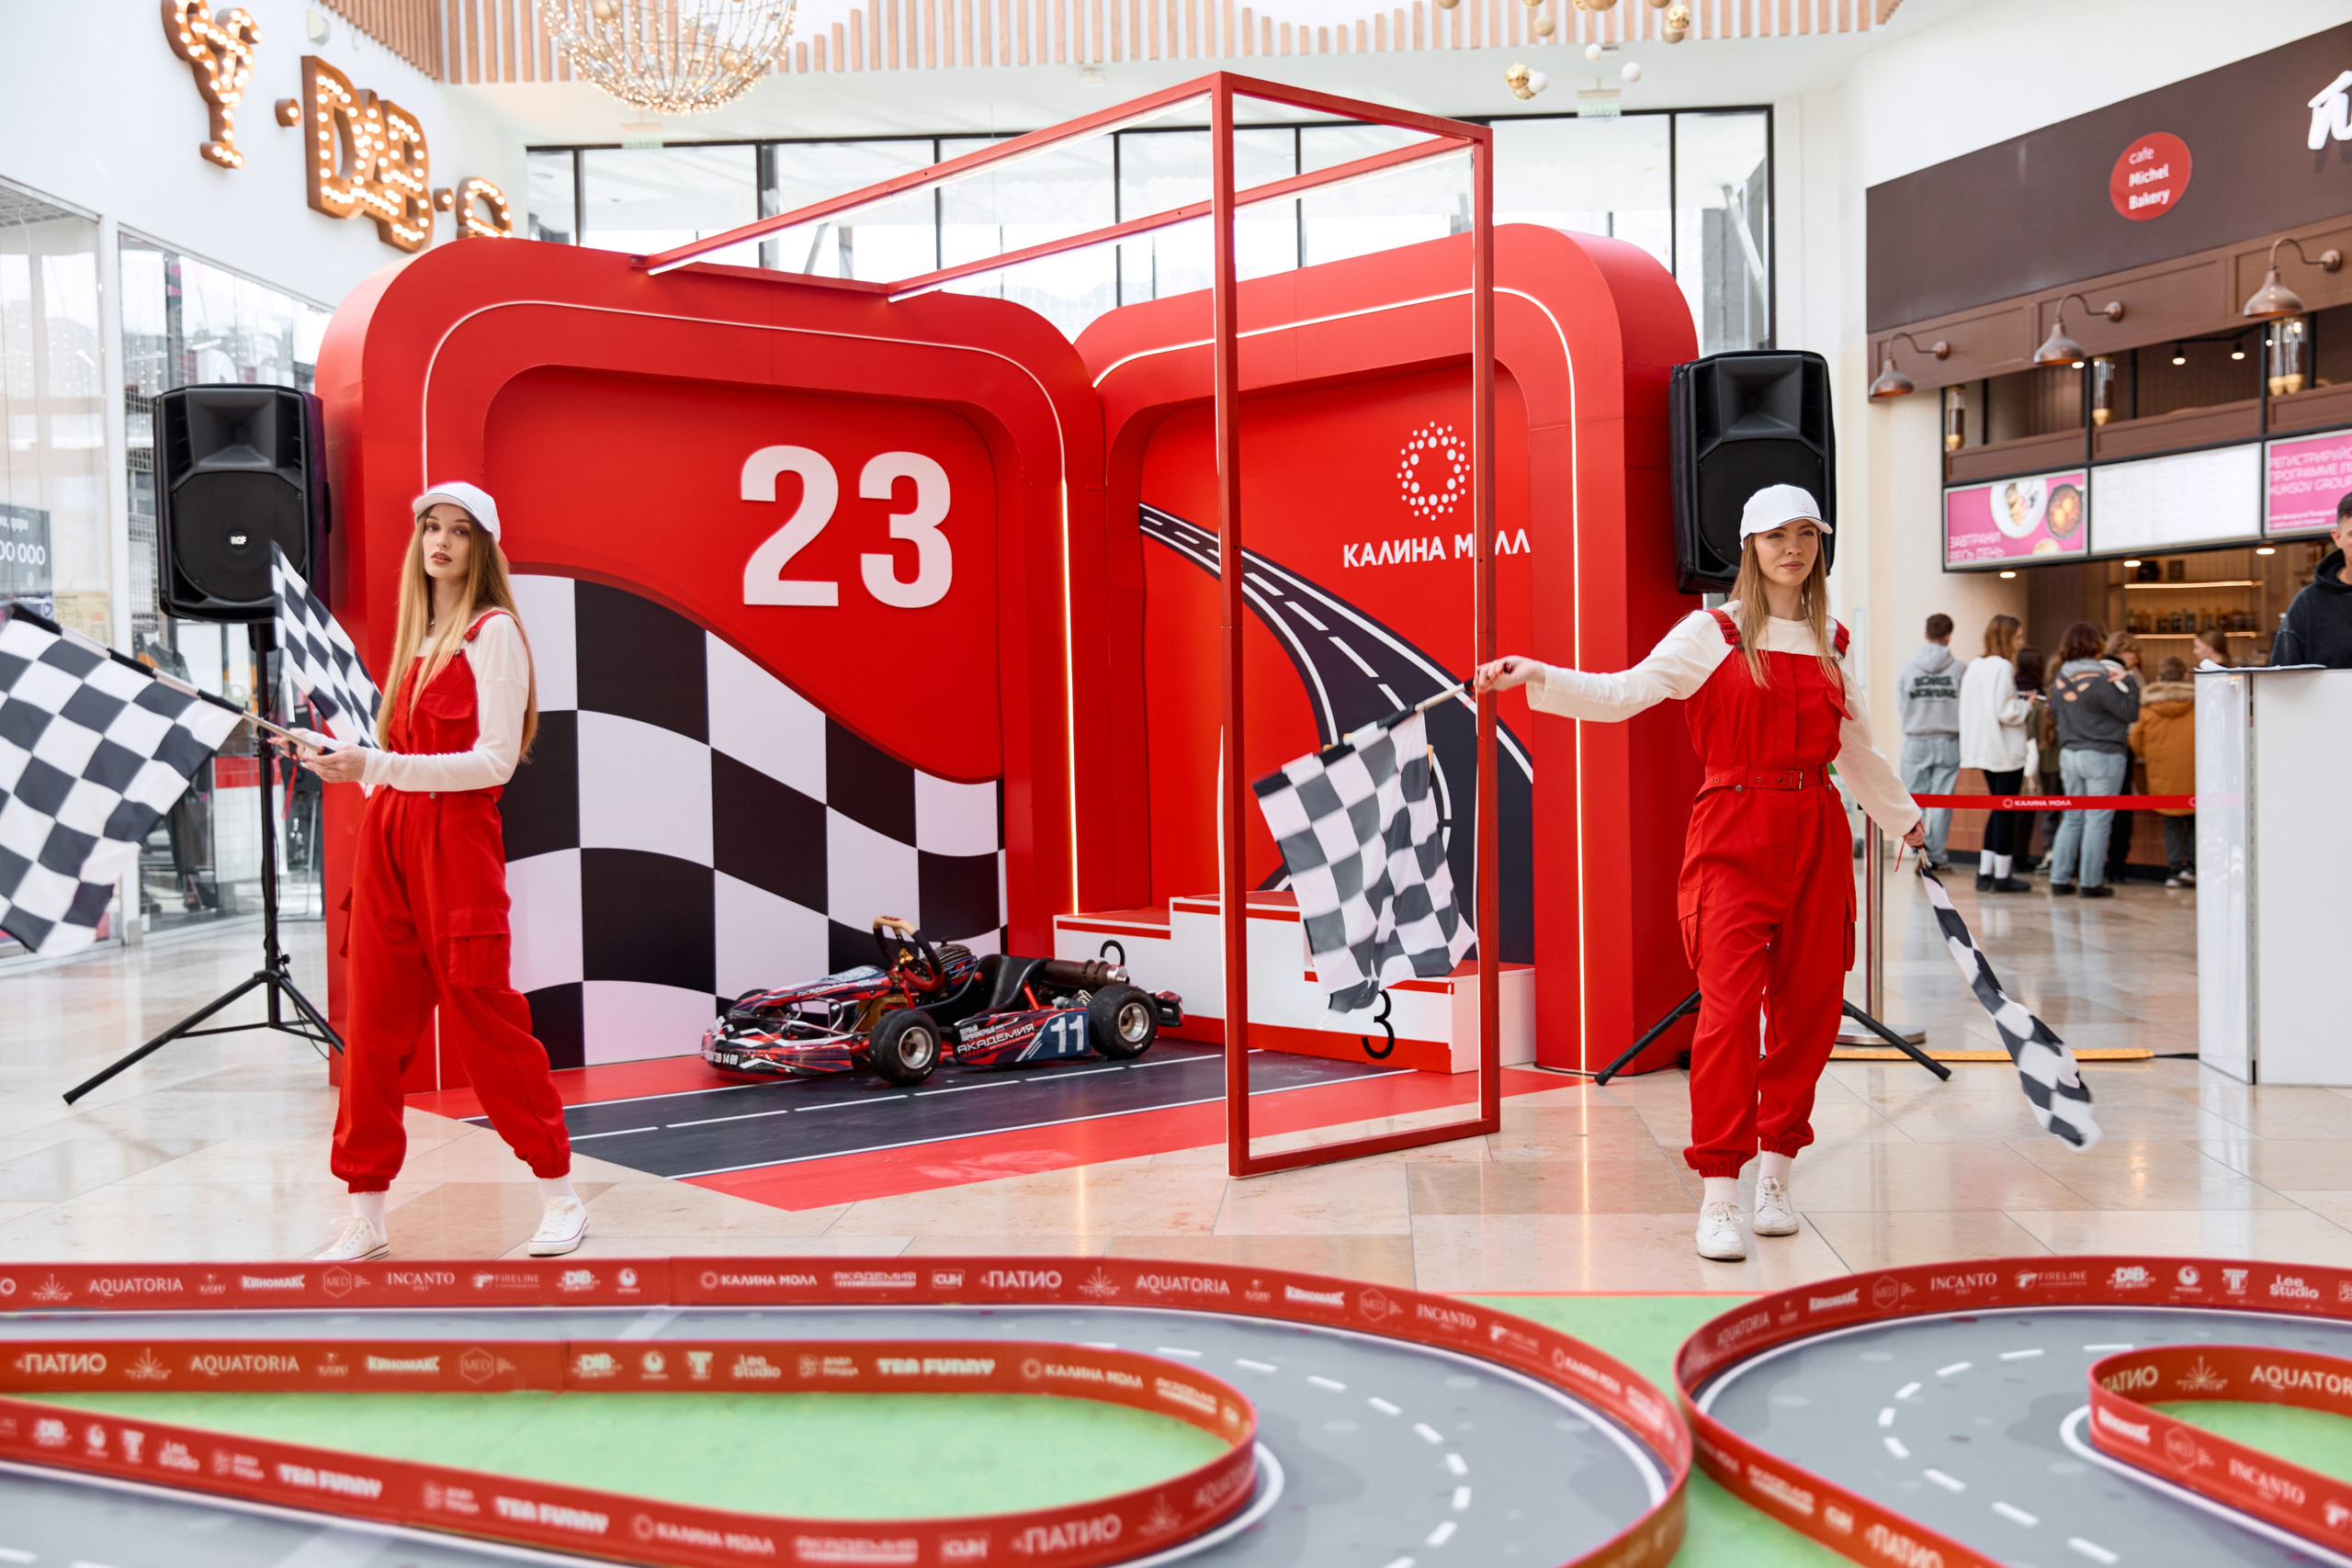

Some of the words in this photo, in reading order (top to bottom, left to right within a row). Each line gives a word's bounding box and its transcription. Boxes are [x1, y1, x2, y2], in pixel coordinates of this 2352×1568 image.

[2129, 146, 2154, 164] cafe
[2129, 163, 2169, 187] Michel
[2129, 189, 2170, 210] Bakery
[741, 445, 953, 608] 23
[1343, 536, 1446, 568] КАЛИНА
[1454, 528, 1532, 559] МЛЛ
[1362, 988, 1395, 1059] 3
[956, 1023, 1035, 1054] АКАДЕМИЯ
[1050, 1015, 1085, 1054] 11
[242, 1274, 306, 1289] КИНОМАКС
[326, 1277, 349, 1287] MED
[387, 1272, 456, 1285] INCANTO
[495, 1274, 540, 1283] FIRELINE
[721, 1275, 776, 1286] КАЛИНА
[779, 1275, 818, 1286] МОЛЛ
[834, 1271, 917, 1280] АКАДЕМИЯ
[989, 1270, 1062, 1288] ПАТИО
[1930, 1272, 1997, 1291] INCANTO
[2039, 1271, 2087, 1280] FIRELINE
[2115, 1266, 2145, 1282] DAB
[2276, 1274, 2303, 1287] Lee
[89, 1278, 184, 1296] AQUATORIA
[1136, 1274, 1230, 1294] AQUATORIA
[1876, 1286, 1896, 1298] MED
[2269, 1283, 2320, 1299] Studio
[1285, 1285, 1344, 1305] КИНОМАКС
[1808, 1289, 1859, 1312] КИНОМАКС
[1363, 1298, 1385, 1311] MED
[1416, 1303, 1476, 1328] INCANTO
[1717, 1312, 1770, 1347] AQUATORIA
[26, 1353, 107, 1373] ПАТИО
[190, 1355, 300, 1376] AQUATORIA
[368, 1355, 440, 1372] КИНОМАКС
[464, 1359, 491, 1371] MED
[741, 1354, 767, 1366] Lee
[877, 1358, 921, 1374] TEA
[734, 1364, 781, 1378] Studio
[1045, 1364, 1104, 1382] КАЛИНА
[1105, 1370, 1144, 1390] МОЛЛ
[2102, 1365, 2158, 1393] ПАТИО
[2229, 1459, 2305, 1505] INCANTO
[656, 1521, 724, 1547] КАЛИНА
[1024, 1513, 1123, 1553] ПАТИО
